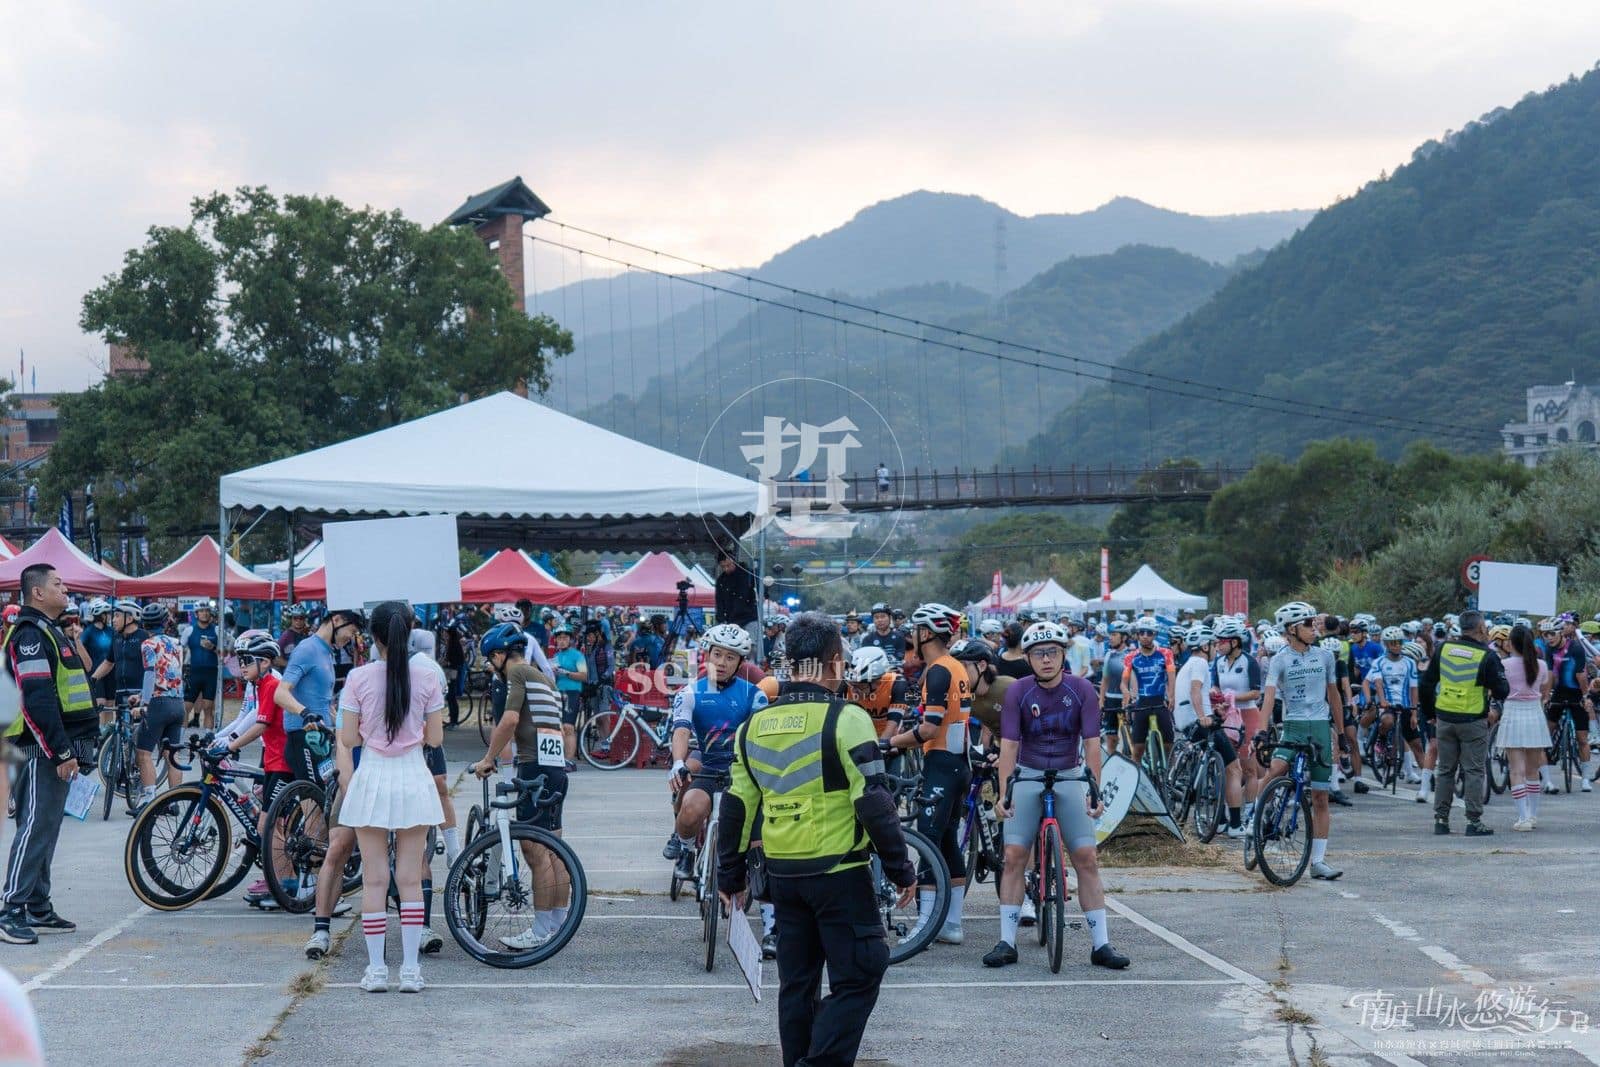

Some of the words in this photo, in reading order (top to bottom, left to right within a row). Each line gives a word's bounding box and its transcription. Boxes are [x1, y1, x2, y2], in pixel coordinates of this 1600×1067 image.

[1032, 630, 1053, 641] 336
[1287, 667, 1324, 677] SHINING
[780, 715, 804, 729] JUDGE
[540, 738, 562, 756] 425
